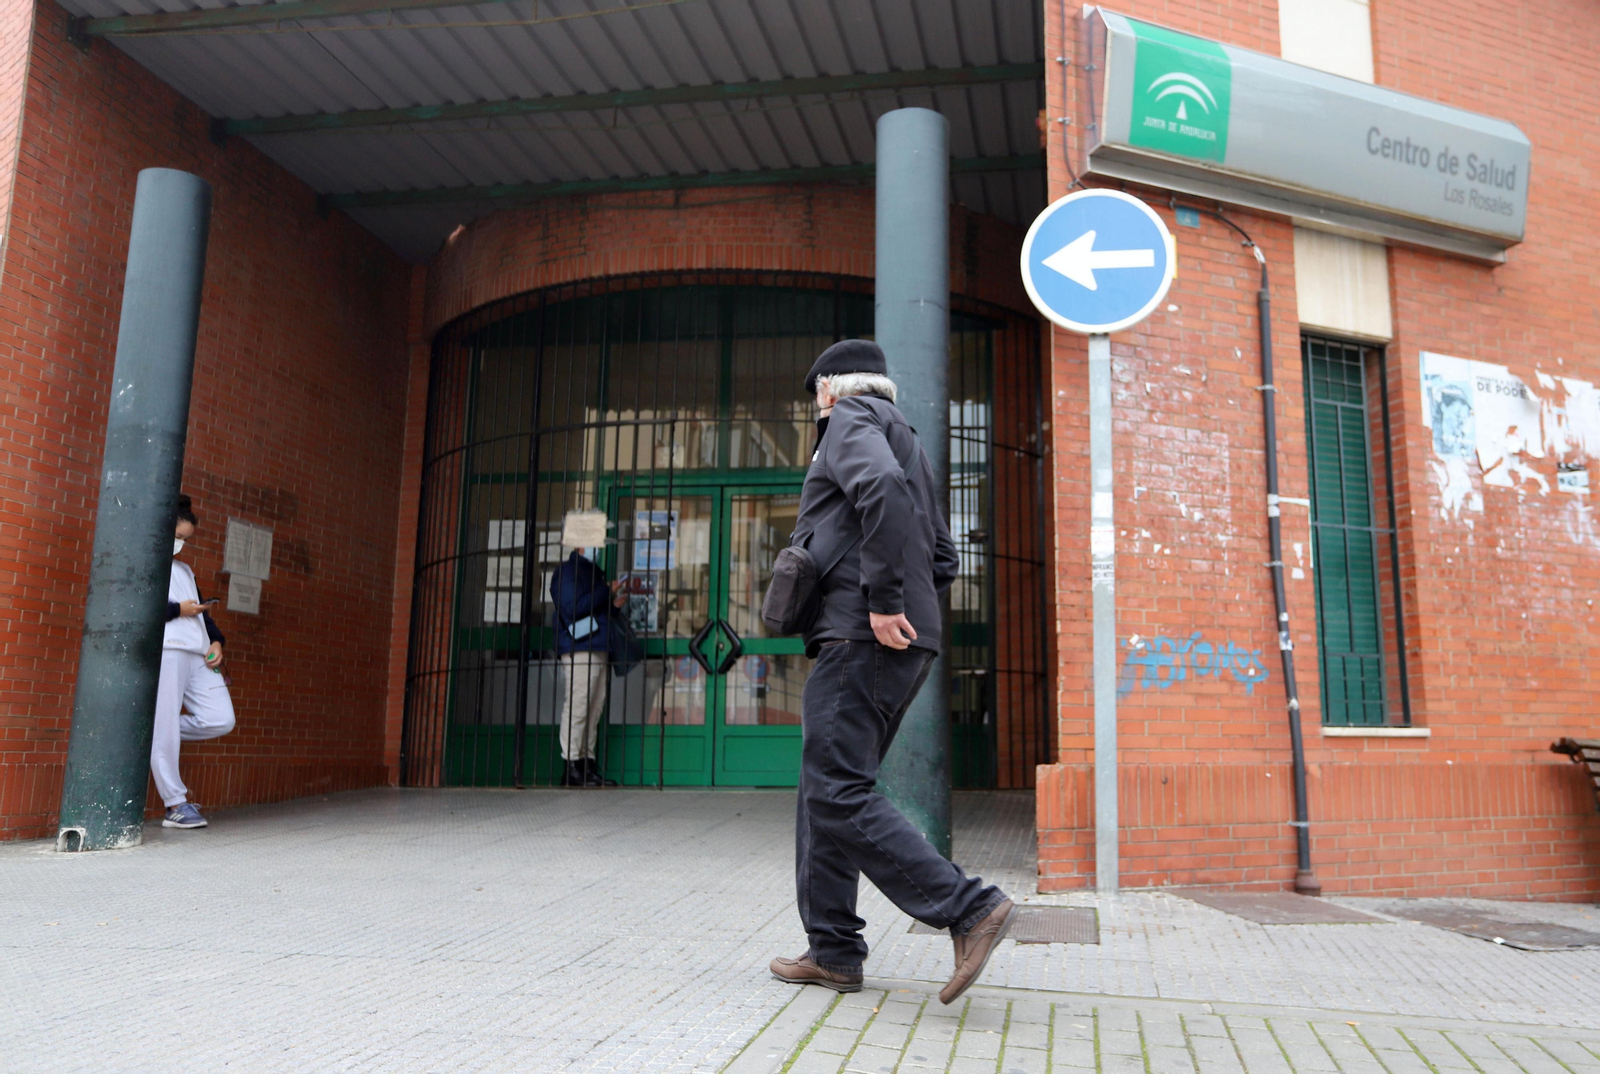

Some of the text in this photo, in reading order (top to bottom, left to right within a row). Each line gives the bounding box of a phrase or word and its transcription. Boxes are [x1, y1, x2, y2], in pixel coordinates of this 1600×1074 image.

[1143, 116, 1166, 130] JUNTA
[1168, 121, 1178, 133] DE
[1366, 126, 1517, 192] Centro de Salud
[1444, 182, 1514, 217] Los Rosales
